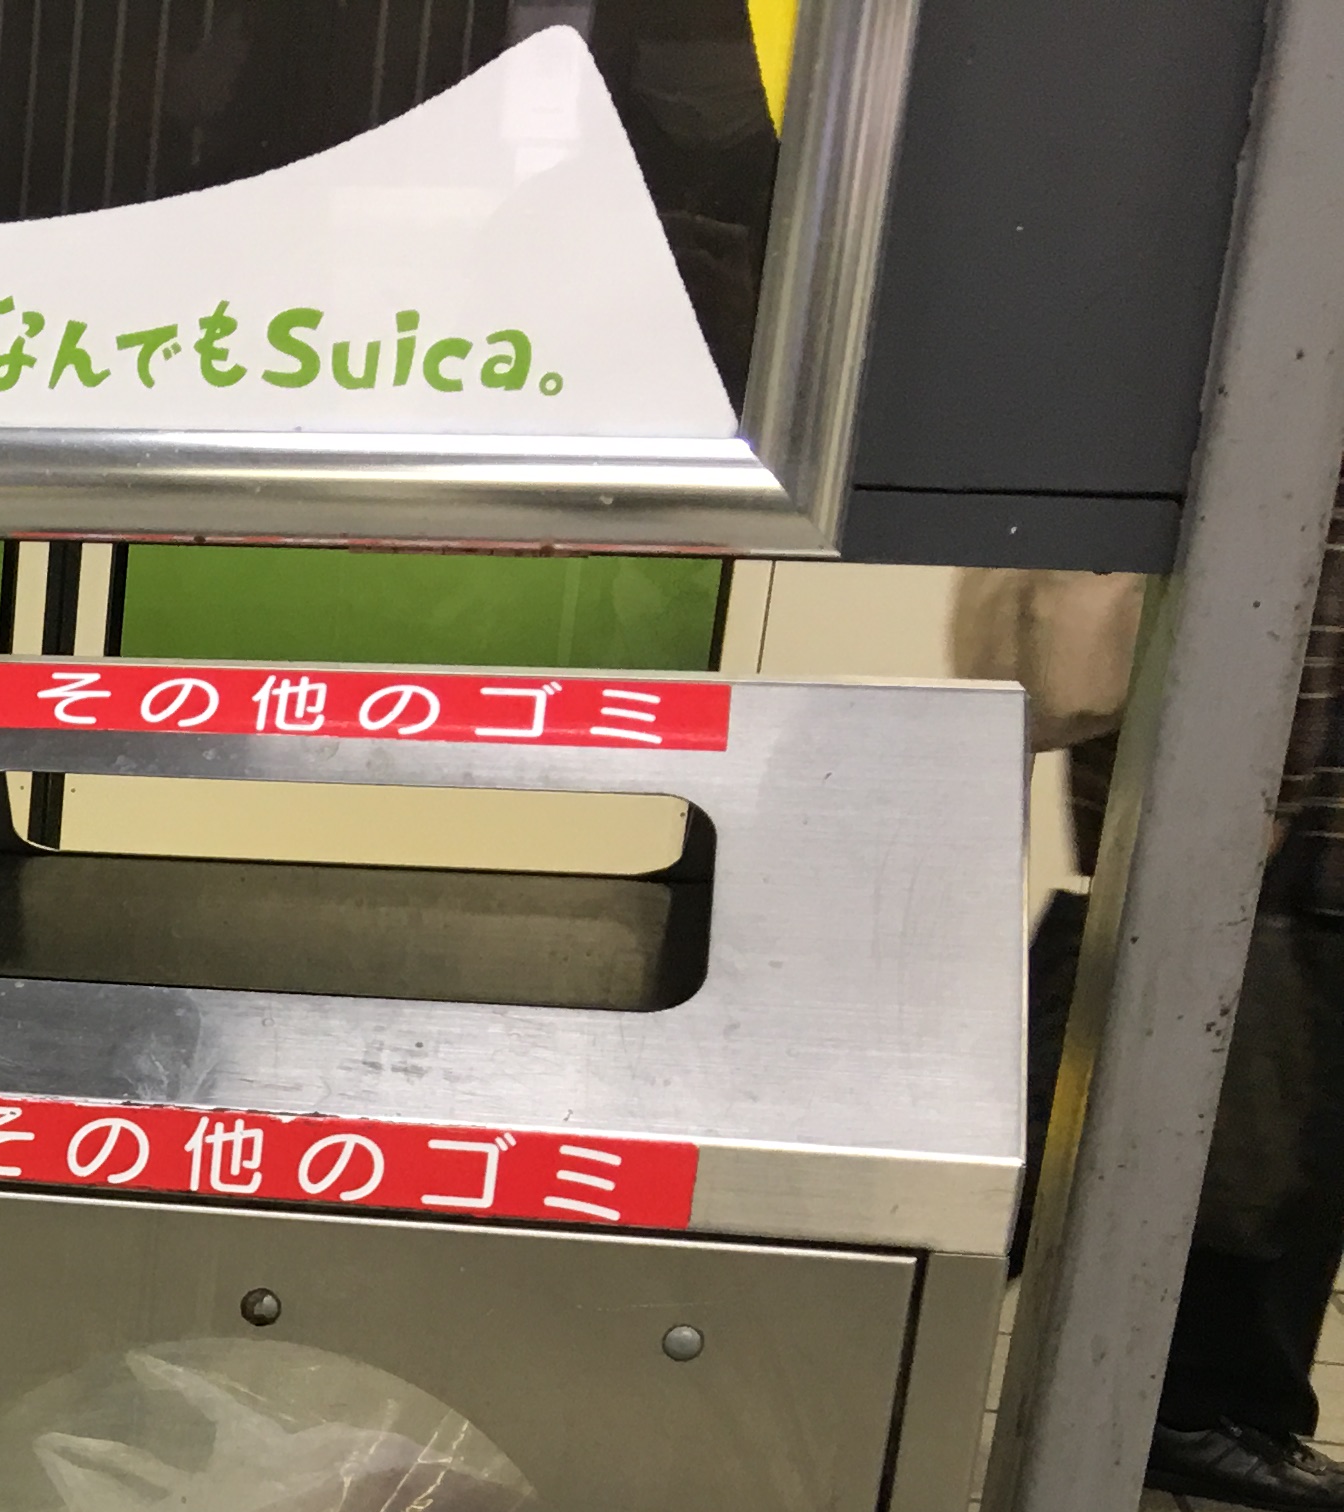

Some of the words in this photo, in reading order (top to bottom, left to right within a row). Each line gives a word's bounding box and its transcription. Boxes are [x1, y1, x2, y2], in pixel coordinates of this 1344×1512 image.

[37, 672, 663, 744] その他のゴミ
